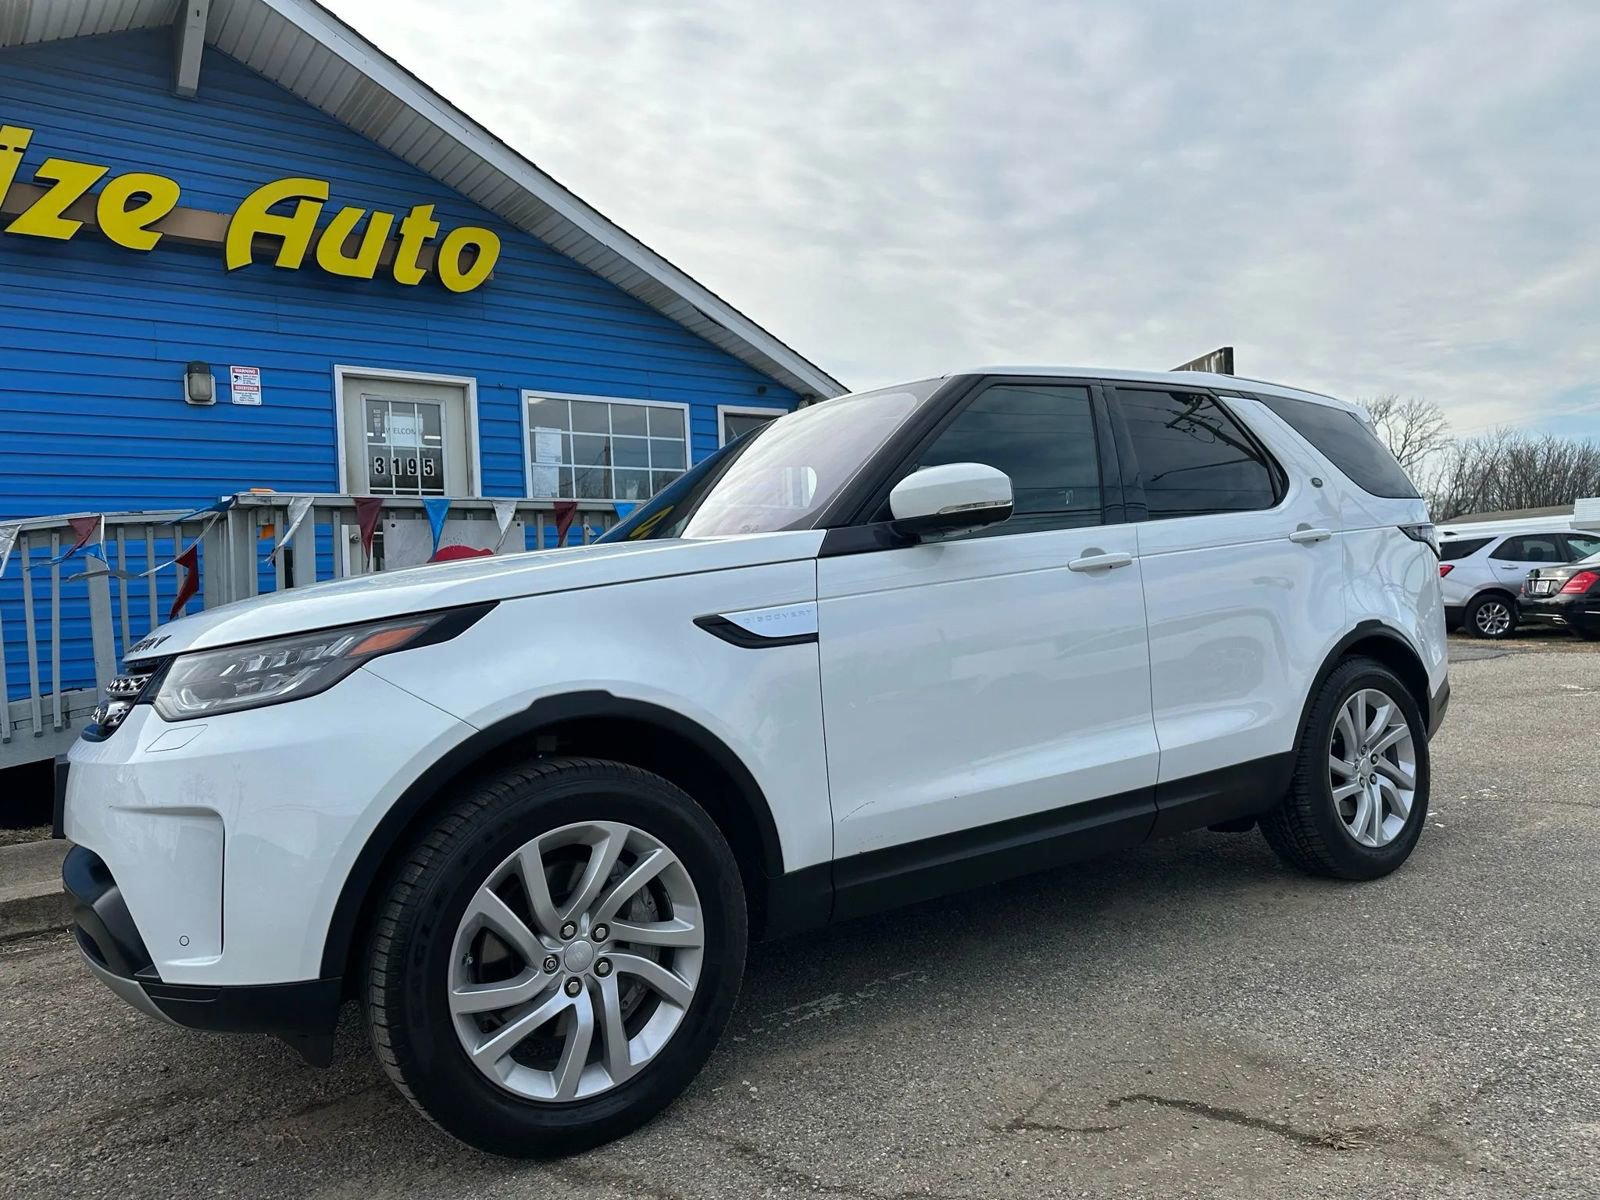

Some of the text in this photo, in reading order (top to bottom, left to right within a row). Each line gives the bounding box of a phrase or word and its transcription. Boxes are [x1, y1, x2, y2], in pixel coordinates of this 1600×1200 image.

[225, 177, 500, 293] Auto
[375, 457, 433, 475] 3195
[743, 609, 812, 625] DISCOVERY
